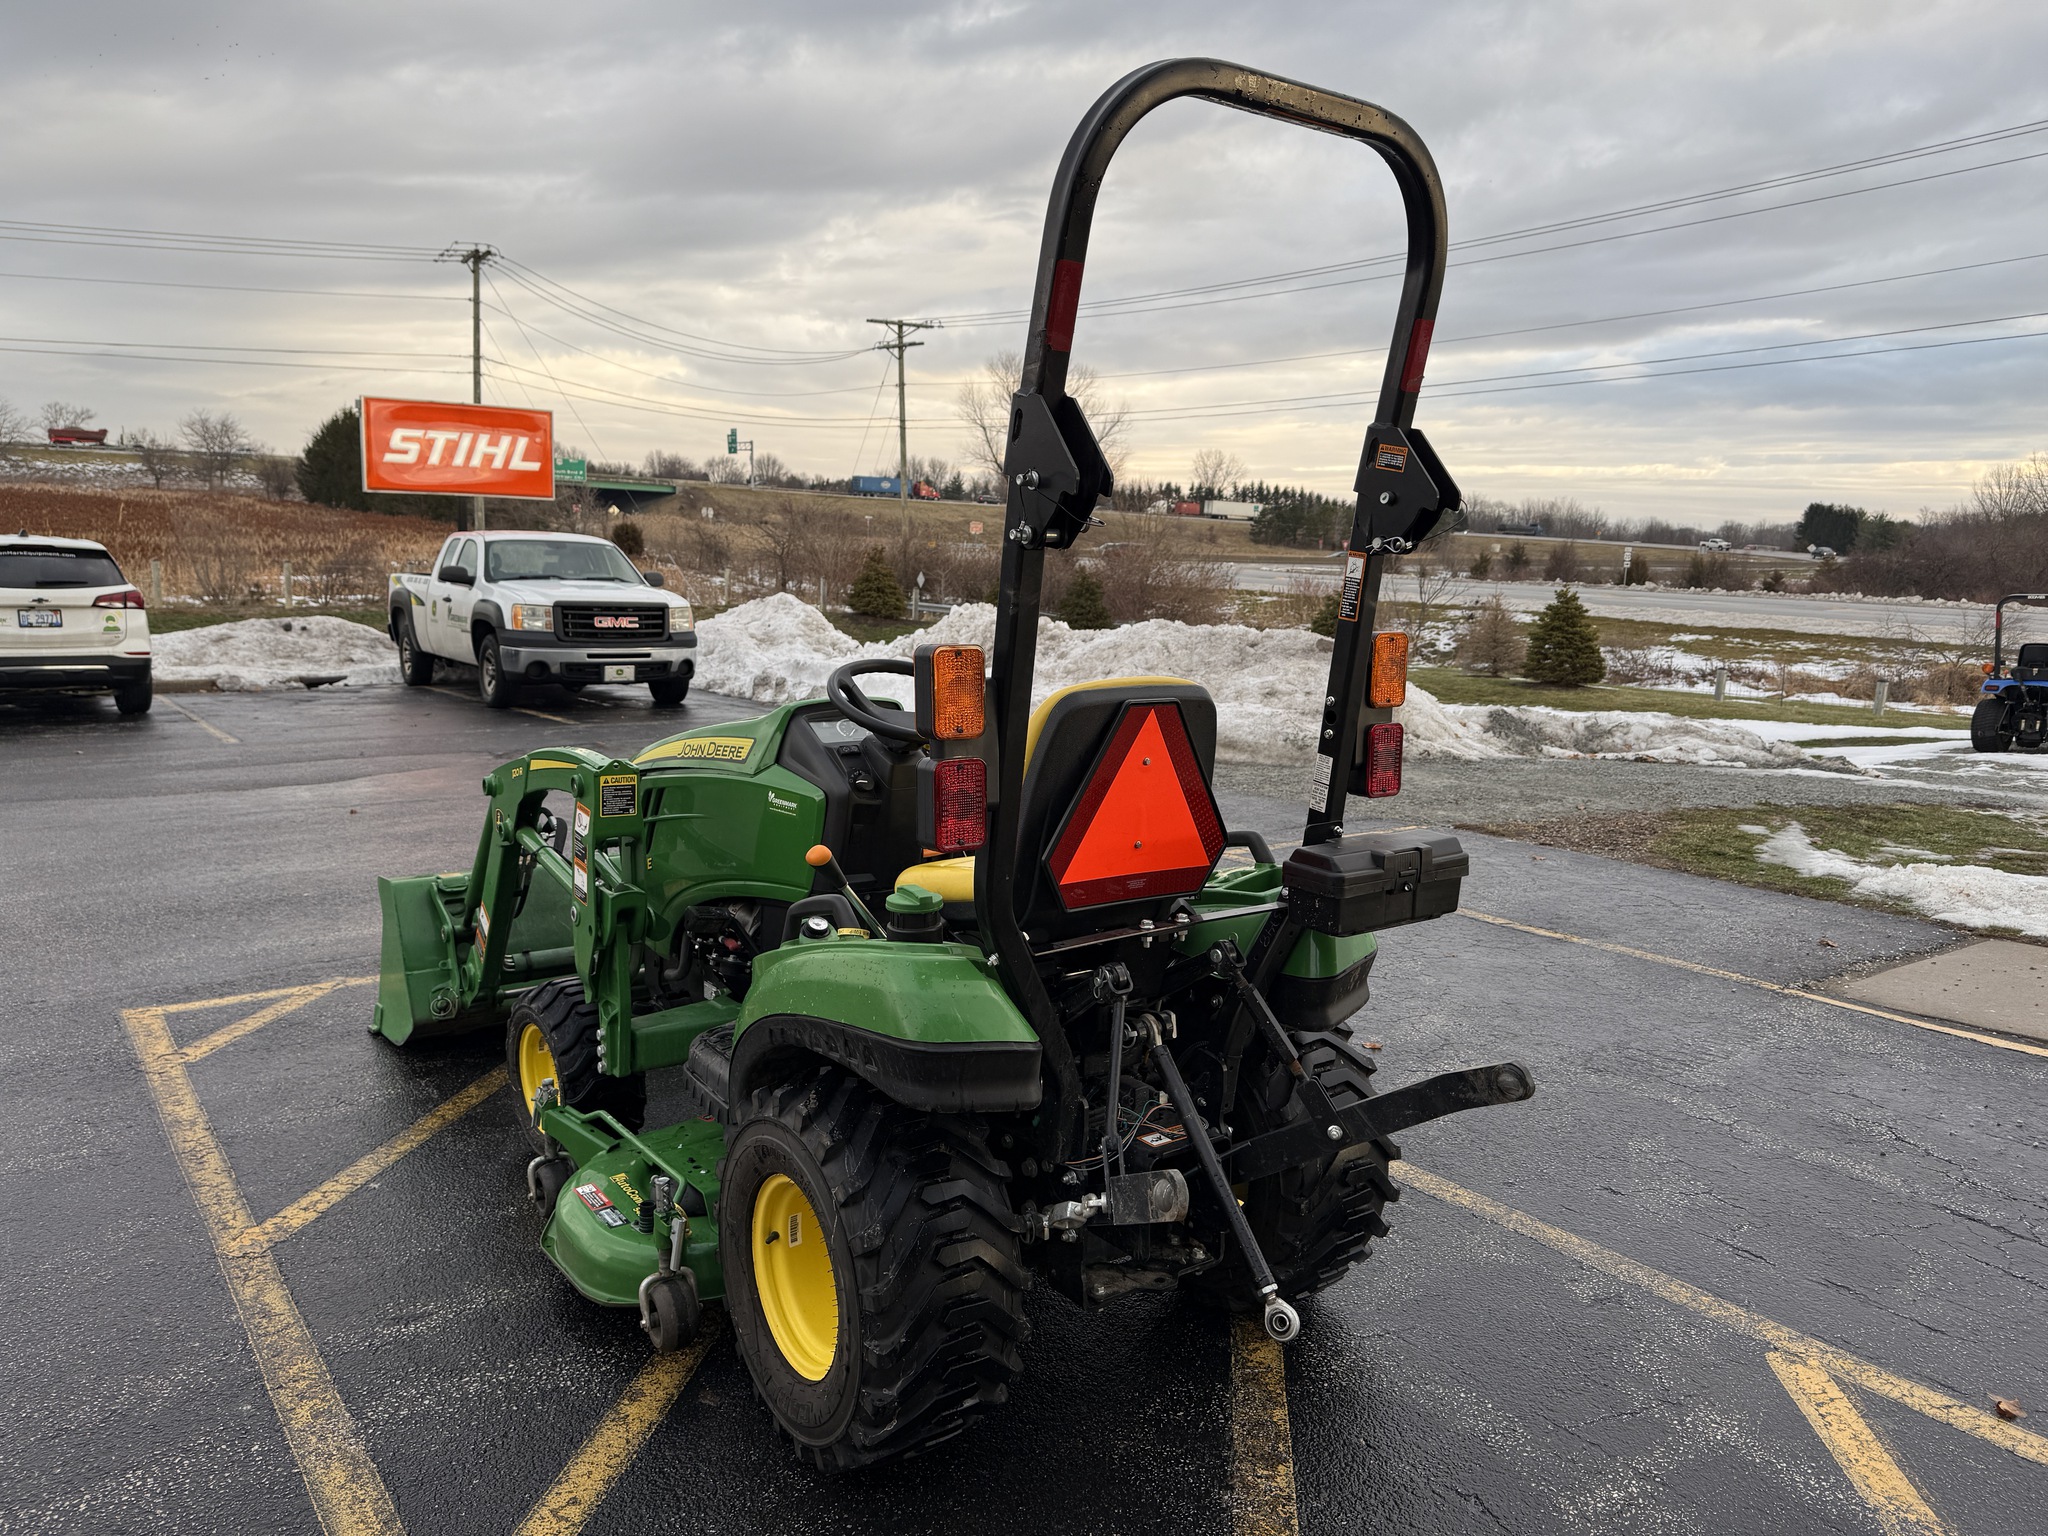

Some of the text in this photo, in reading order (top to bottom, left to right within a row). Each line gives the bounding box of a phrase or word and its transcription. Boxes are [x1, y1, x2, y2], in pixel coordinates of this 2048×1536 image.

[382, 427, 542, 472] STIHL
[594, 616, 640, 628] GMC
[677, 742, 745, 758] JOHN DEERE
[610, 776, 636, 784] CAUTION
